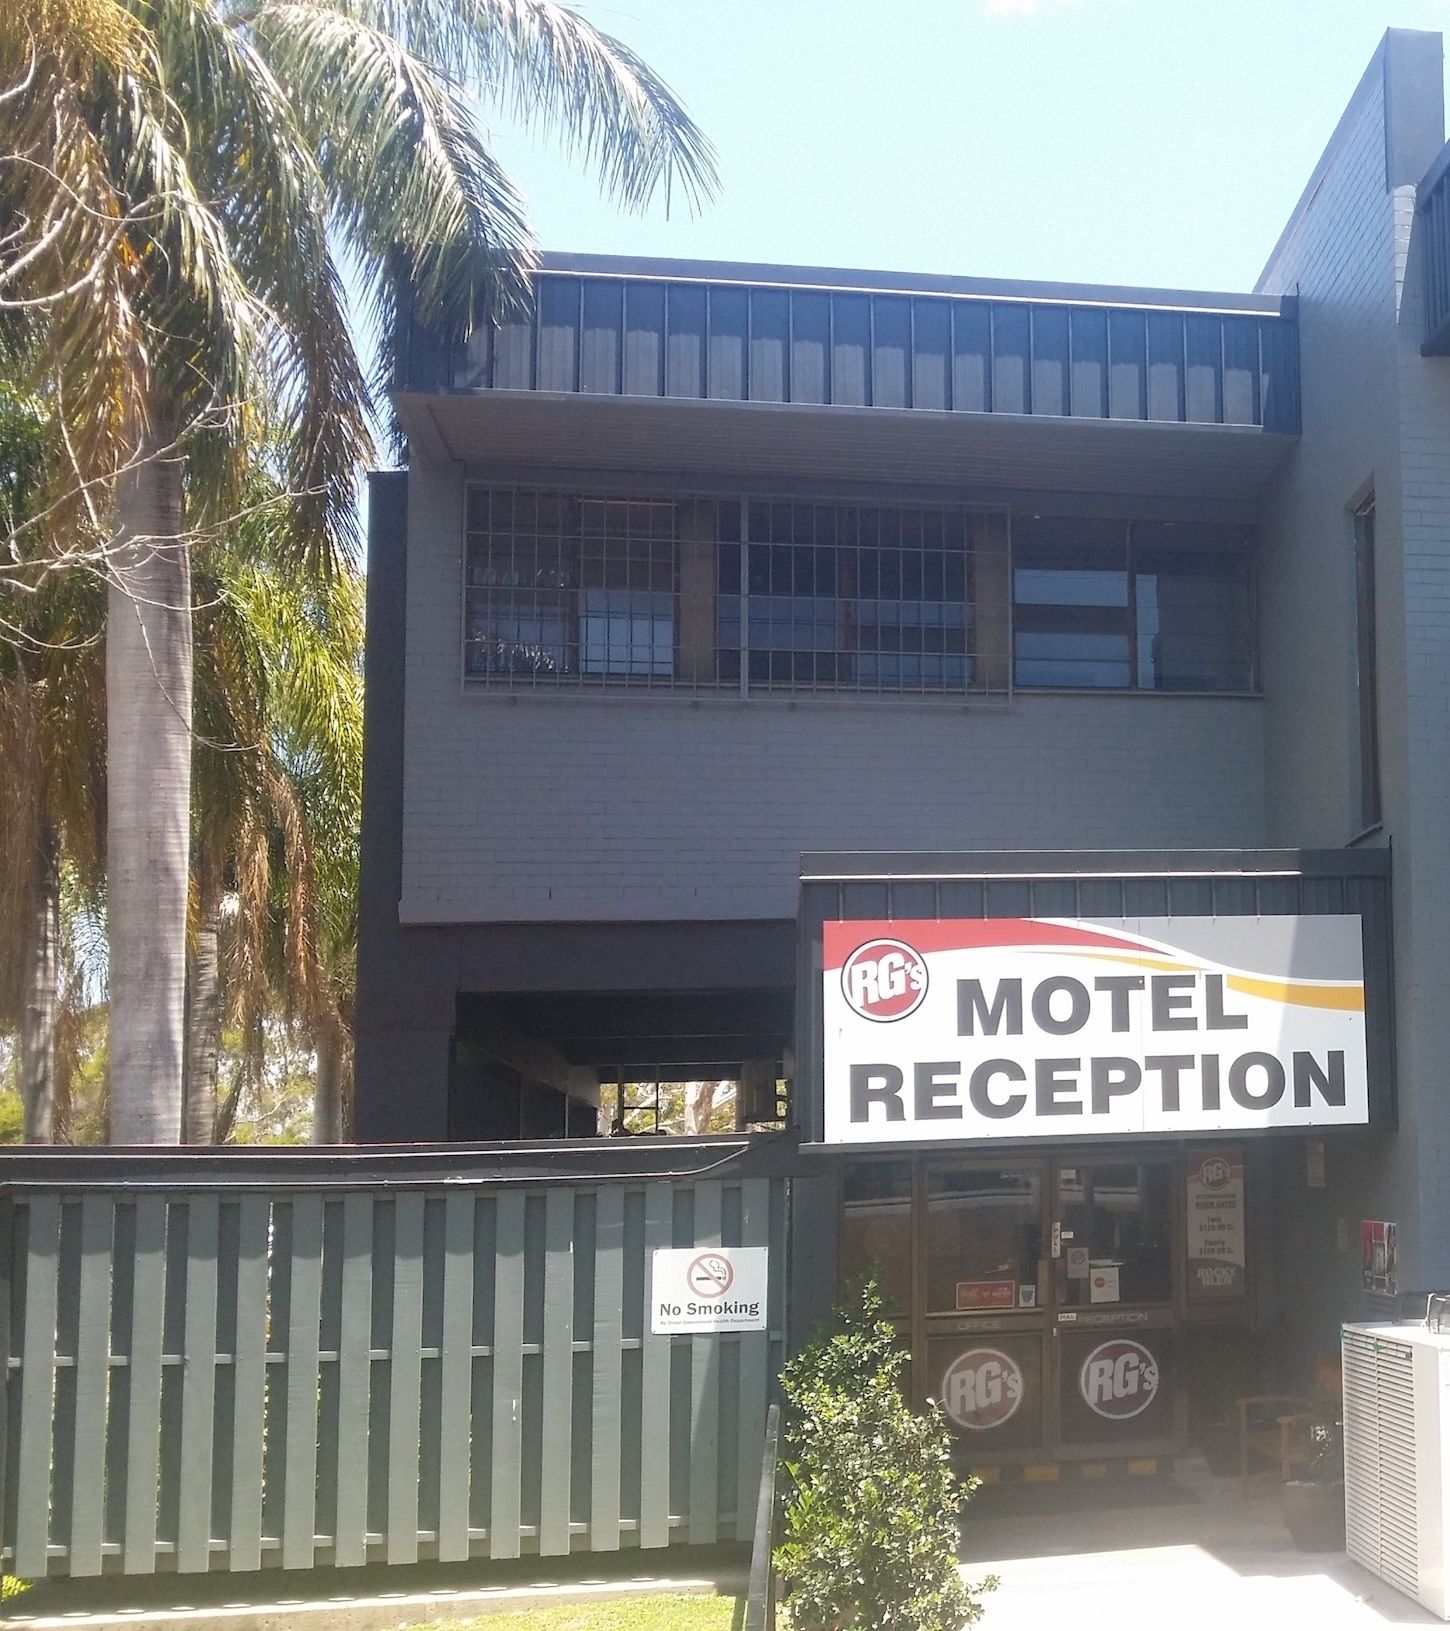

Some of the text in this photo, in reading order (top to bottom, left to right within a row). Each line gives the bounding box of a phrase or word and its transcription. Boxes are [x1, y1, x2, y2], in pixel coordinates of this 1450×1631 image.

[851, 951, 924, 1008] RG's
[956, 973, 1249, 1037] MOTEL
[849, 1050, 1347, 1124] RECEPTION
[660, 1301, 760, 1316] No Smoking
[958, 1320, 1002, 1330] OFFICE
[949, 1361, 1019, 1417] RG's
[1088, 1352, 1159, 1406] RG's
